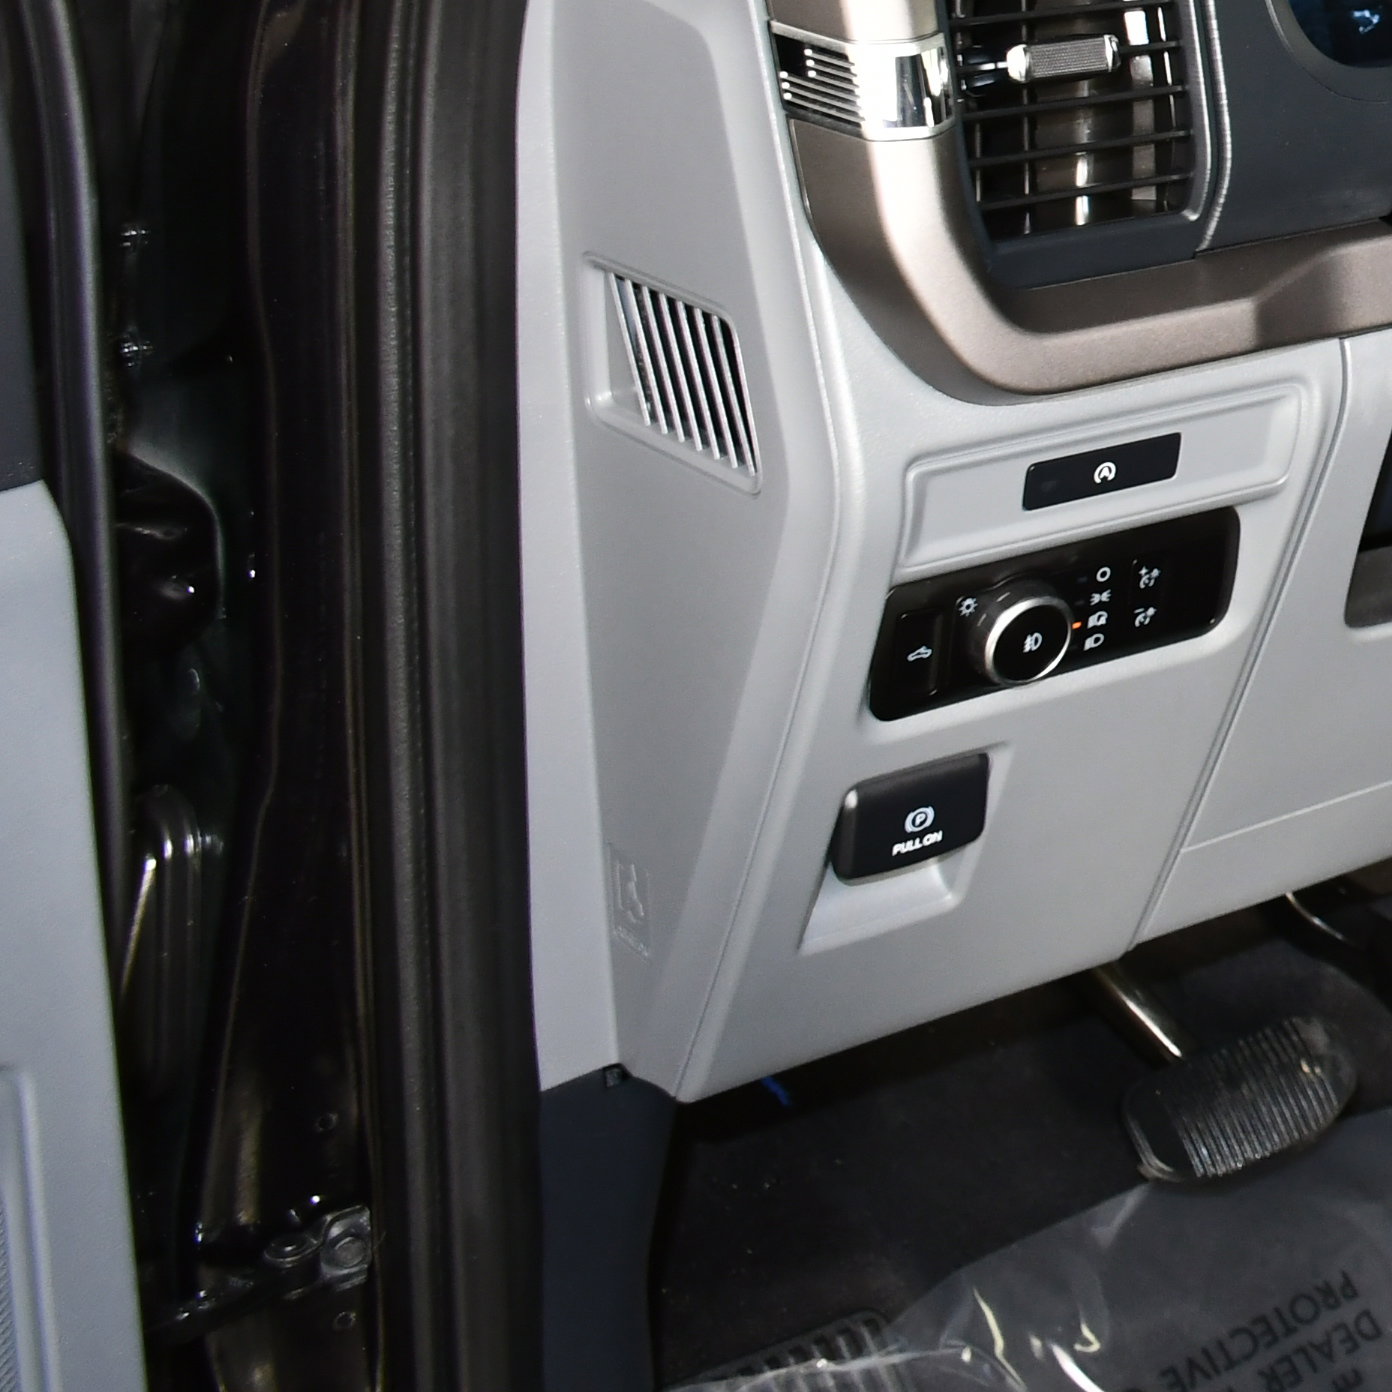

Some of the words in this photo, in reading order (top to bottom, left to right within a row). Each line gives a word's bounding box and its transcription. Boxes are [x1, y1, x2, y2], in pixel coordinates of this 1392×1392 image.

[891, 837, 922, 857] PULL
[922, 830, 943, 846] ON
[1157, 1269, 1359, 1392] PROTECTIVE
[1257, 1309, 1383, 1392] DEALER
